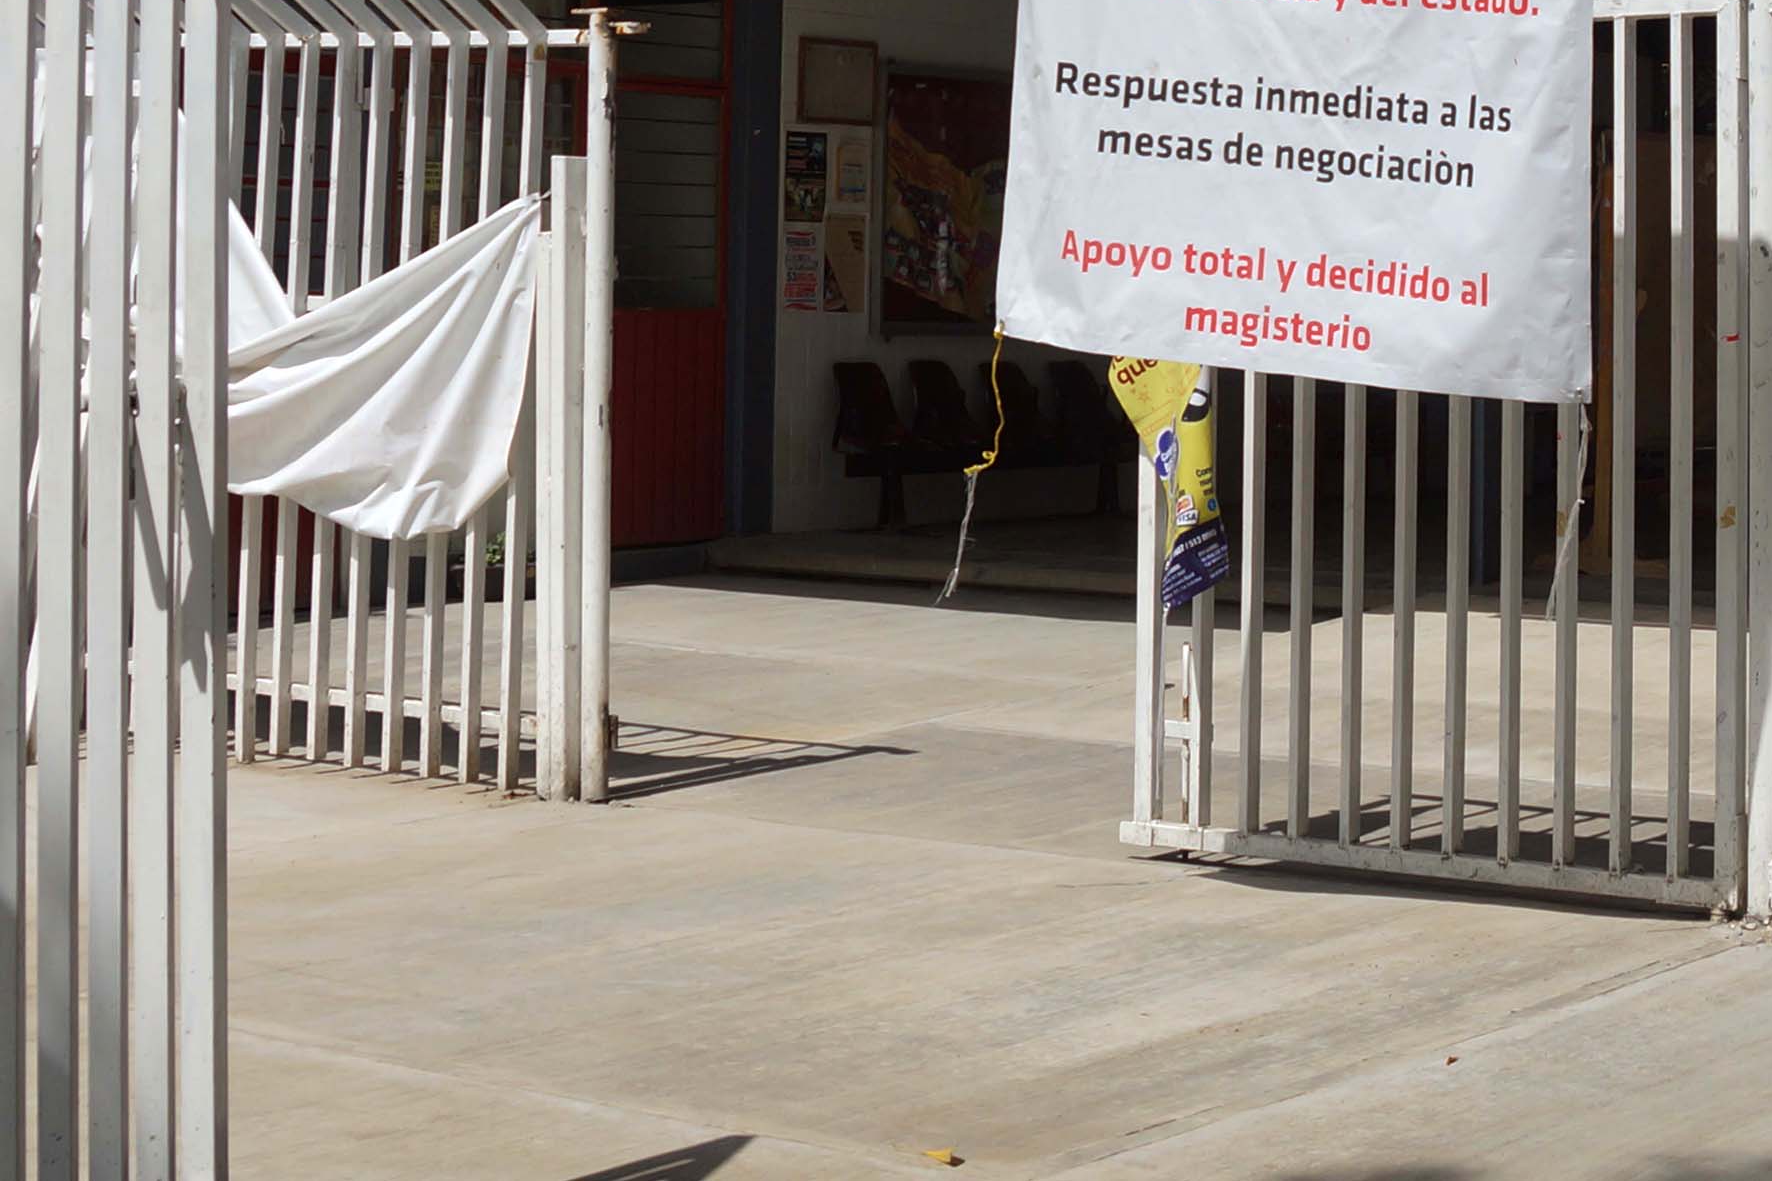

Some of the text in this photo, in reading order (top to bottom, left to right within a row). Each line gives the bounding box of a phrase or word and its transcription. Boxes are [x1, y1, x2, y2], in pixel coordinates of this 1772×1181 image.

[1055, 62, 1511, 132] Respuesta inmediata a las
[1098, 130, 1212, 162] mesas
[1223, 132, 1263, 167] de
[1061, 229, 1489, 308] Apoyo total y decidido al
[1184, 306, 1372, 352] magisterio
